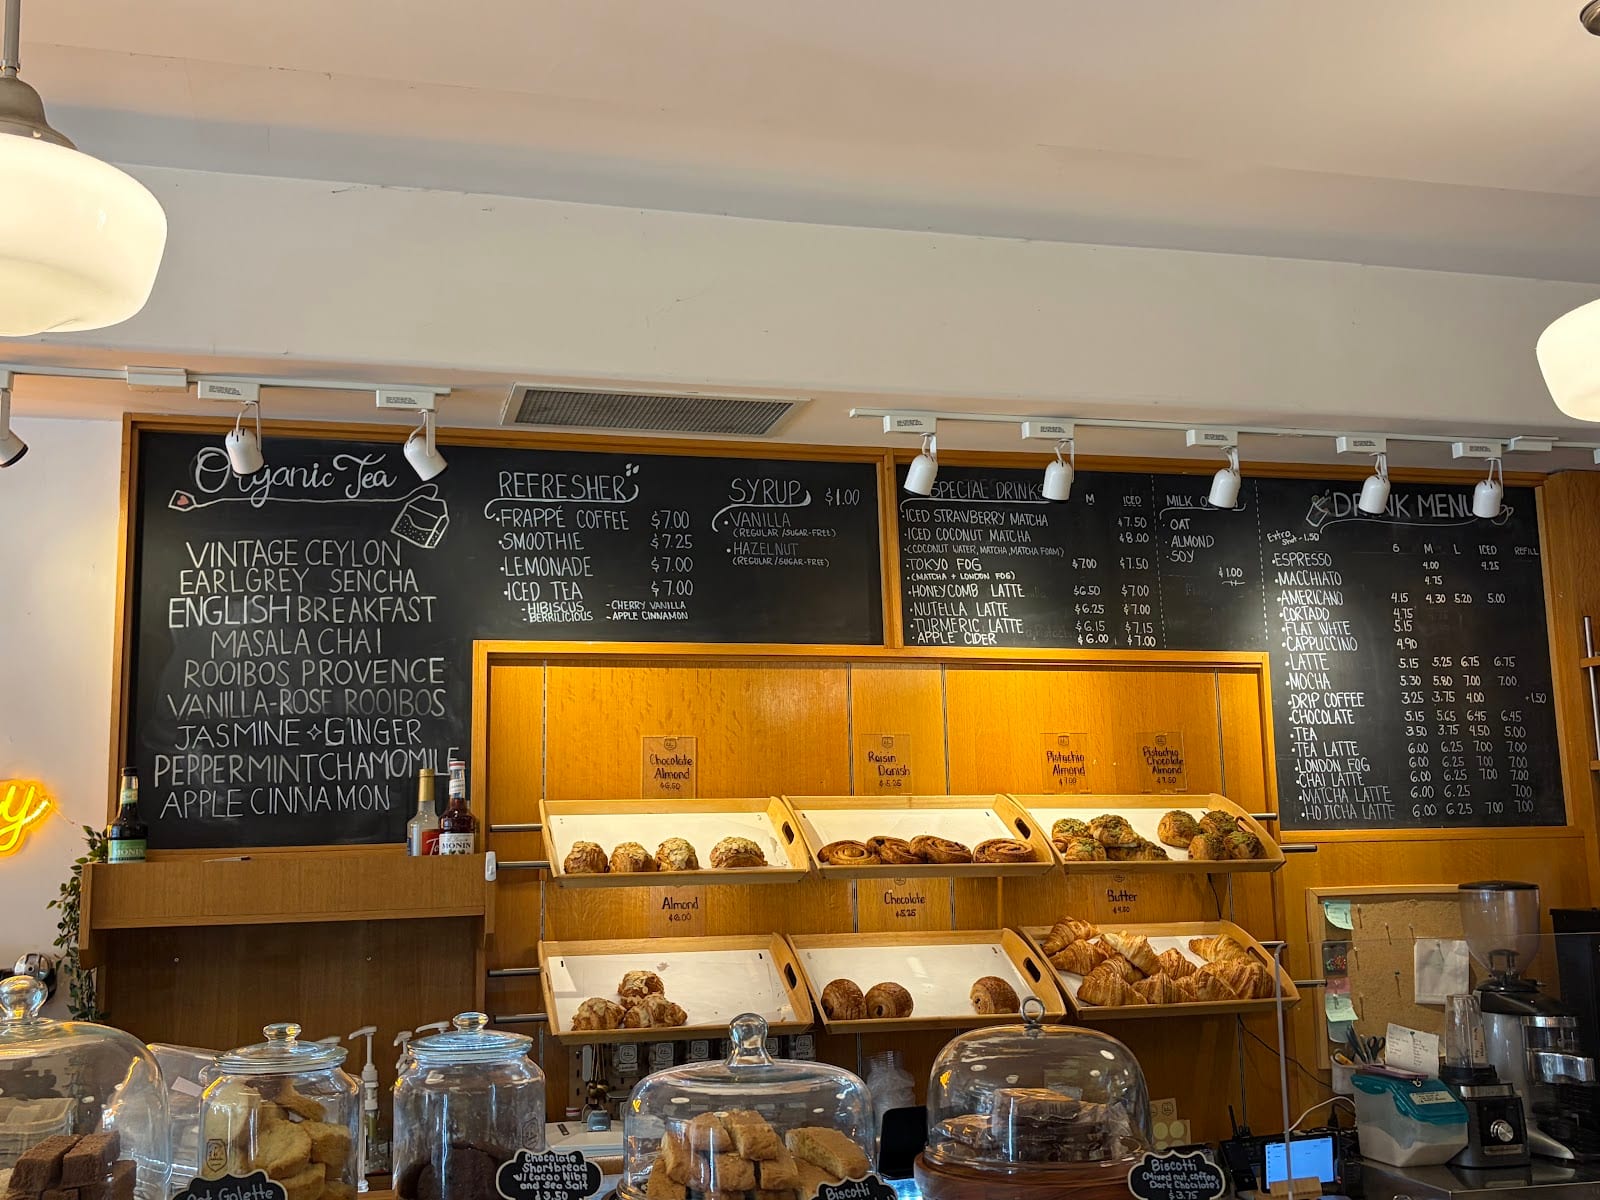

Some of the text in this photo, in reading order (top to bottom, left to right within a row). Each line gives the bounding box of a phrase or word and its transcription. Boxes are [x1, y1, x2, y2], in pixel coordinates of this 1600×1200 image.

[195, 447, 397, 508] Organic Tea
[499, 471, 627, 500] REFRESHER
[728, 478, 860, 506] SYRUP $1.00
[1086, 493, 1142, 505] M ICED
[1166, 494, 1193, 507] MILK
[1333, 492, 1411, 518] DRNK
[576, 509, 630, 530] COFFEE
[651, 510, 689, 529] $7.00
[729, 512, 791, 528] VANILLA
[905, 509, 931, 522] ICED
[933, 509, 1005, 526] STRAWBERRY
[1010, 512, 1049, 527] MATCHA
[1170, 518, 1191, 530] OAT
[501, 532, 693, 550] SMOOTHIE $7.25
[908, 527, 931, 541] ICED
[936, 527, 983, 542] COCONUT
[989, 529, 1032, 542] MATCHA
[1171, 535, 1215, 548] ALMOND
[186, 539, 400, 568] VINTAGE CEYLON
[733, 541, 799, 556] HAZELNUT
[1423, 543, 1539, 556] M L ICED REFILL
[1169, 550, 1194, 563] SOY
[1273, 552, 1332, 567] ESPRESSO
[504, 556, 693, 577] LEMONADE $7.00
[907, 558, 949, 571] TOKYO
[957, 558, 982, 571] FOG
[329, 568, 419, 593] SENCHA
[960, 572, 990, 580] LONDON
[1278, 570, 1342, 586] MACCHIATO
[507, 580, 693, 601] ICED TEA $7.00
[911, 583, 1025, 597] HONEYCOMB LATTE
[1281, 589, 1344, 606] AMERICANO
[1425, 594, 1446, 604] 4.30
[168, 595, 437, 628] ENGLISH BREAKFAST
[528, 600, 584, 613] HIBISCUS
[611, 600, 686, 611] CHERRY VANILLA
[914, 601, 1151, 616] NUTELLA LATTE $6.25 $7.00
[529, 611, 594, 623] BERRILICIOUS
[612, 611, 688, 621] APPLE CINNAMON
[1283, 606, 1330, 621] CORTADO
[913, 618, 1105, 633] TURMERIC LATTE $6.15
[1285, 621, 1313, 635] FLAT
[211, 627, 382, 659] MASALA CHAI
[917, 632, 1156, 647] APPLE CIDER $6.00 $7.00
[1286, 636, 1358, 651] CAPPUCCINO
[1290, 653, 1329, 670] LATTE
[1431, 656, 1453, 668] 5.25
[184, 657, 445, 689] ROOIBOS PROVENCE
[1289, 672, 1331, 690] MOCHA
[167, 688, 447, 720] VANILLA-ROSE ROOIBOS
[1291, 692, 1320, 709] DRIP
[1324, 692, 1365, 708] COFFEE
[1291, 709, 1355, 725] CHOCOLATE
[175, 717, 422, 750] JASMINE GINGER
[1293, 727, 1318, 741] TEA
[868, 750, 897, 763] Raisin
[1046, 750, 1085, 763] Pistachio
[1142, 745, 1179, 757] Pistachio
[1294, 742, 1318, 757] TEA
[1323, 741, 1359, 757] LATTE
[650, 753, 693, 766] Chocolate
[1146, 756, 1184, 766] Chocolate
[1297, 757, 1370, 773] LONDON FOG
[654, 767, 690, 780] Almond
[878, 764, 911, 776] Danish
[1053, 763, 1086, 776] Almond
[1152, 765, 1182, 775] Almond
[1299, 771, 1364, 788] CHAI LATTE
[160, 784, 391, 819] APPLE CINNAMON
[1301, 786, 1392, 804] MATCHA LATTE
[1305, 803, 1358, 820] HOJICHA
[1361, 803, 1396, 820] LATTE
[662, 896, 699, 910] Almond
[884, 891, 926, 905] Chocolate
[1107, 889, 1138, 902] Butter
[525, 1153, 576, 1163] Chocolate
[1151, 1159, 1197, 1172] Biscotti
[522, 1162, 588, 1173] Shortbread
[529, 1172, 560, 1180] Cacao
[520, 1180, 588, 1190] and Sea Salt
[826, 1182, 871, 1200] Biscotti
